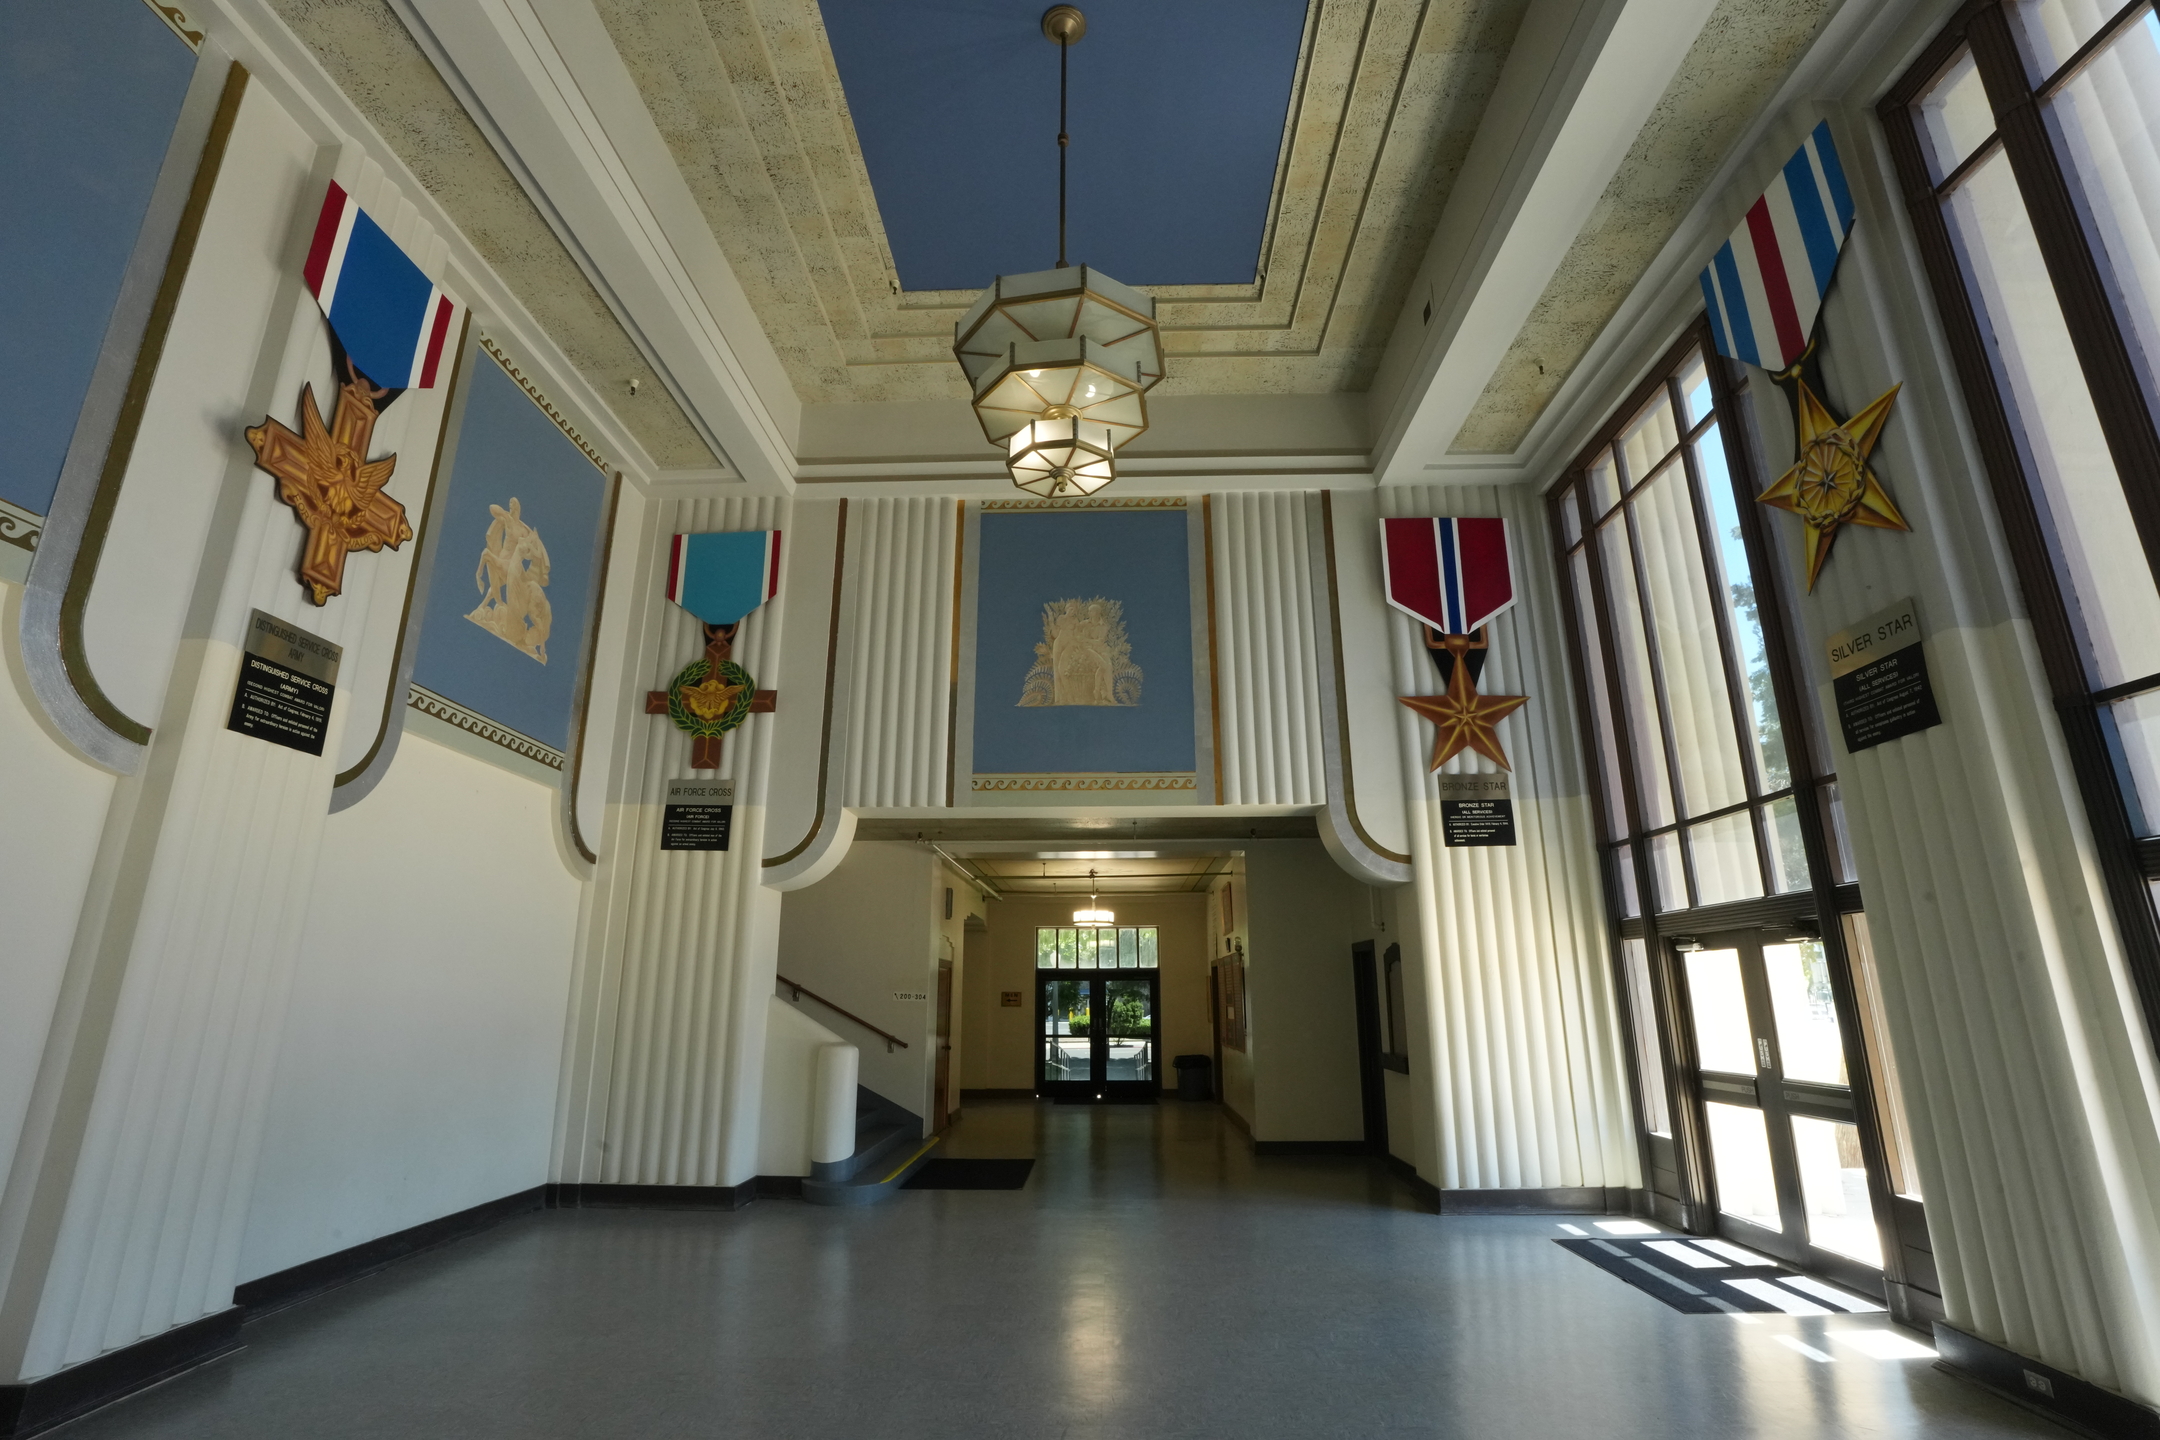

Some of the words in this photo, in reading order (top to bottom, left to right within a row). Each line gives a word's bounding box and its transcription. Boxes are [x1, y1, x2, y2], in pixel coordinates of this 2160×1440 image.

[293, 494, 309, 520] FOR
[349, 534, 373, 548] VALOR
[255, 618, 297, 644] DISTINGUISHED
[298, 637, 321, 655] SERVICE
[321, 647, 339, 662] CROSS
[1831, 633, 1873, 663] SILVER
[1878, 613, 1913, 641] STAR
[288, 647, 305, 662] ARMY
[251, 660, 289, 680] DISTINGUISHED
[290, 675, 311, 688] SERVICE
[312, 683, 328, 694] CROSS
[1855, 667, 1878, 682] SILVER
[1880, 658, 1898, 671] STAR
[280, 683, 298, 694] (ARMY)
[1859, 683, 1870, 692] (ALL
[1871, 671, 1899, 686] SERVICES)
[670, 788, 681, 796] AIR
[683, 788, 706, 796] FORCE
[709, 788, 732, 796] CROSS
[1442, 782, 1479, 791] BRONZE
[1483, 781, 1507, 791] STAR
[1741, 1086, 1754, 1094] PUSH
[1786, 1092, 1800, 1100] PUSH
